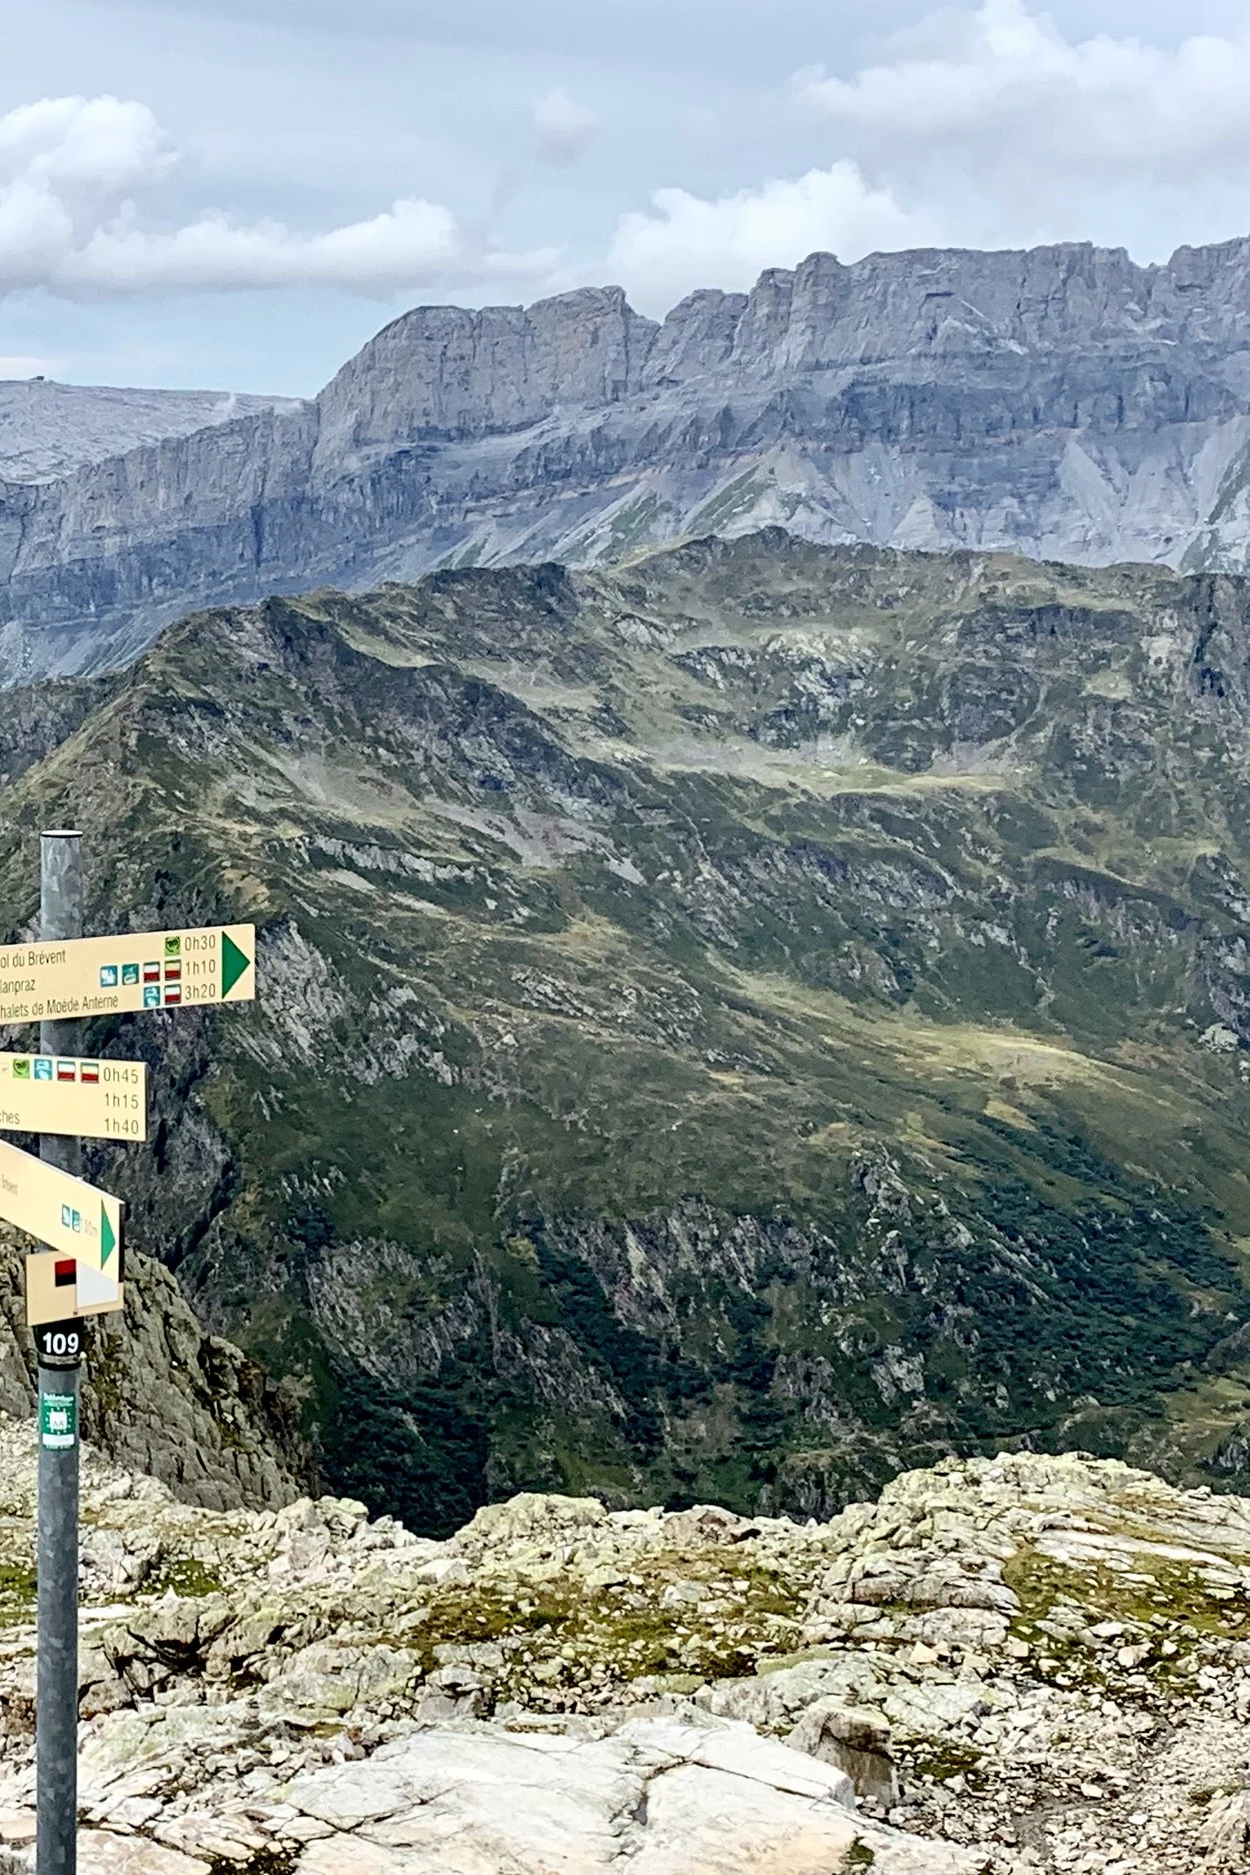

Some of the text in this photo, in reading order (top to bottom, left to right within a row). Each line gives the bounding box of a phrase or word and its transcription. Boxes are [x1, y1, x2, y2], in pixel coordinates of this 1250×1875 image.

[184, 934, 216, 951] 0h30
[12, 952, 24, 968] du
[28, 950, 66, 966] Brévent
[185, 960, 216, 976] 1h10
[184, 984, 216, 1000] 3h20
[32, 1001, 44, 1016] de
[82, 995, 118, 1010] Anterne
[103, 1067, 138, 1084] 0h45
[105, 1092, 139, 1110] 1h15
[105, 1118, 139, 1135] 1h40
[42, 1332, 79, 1354] 109
